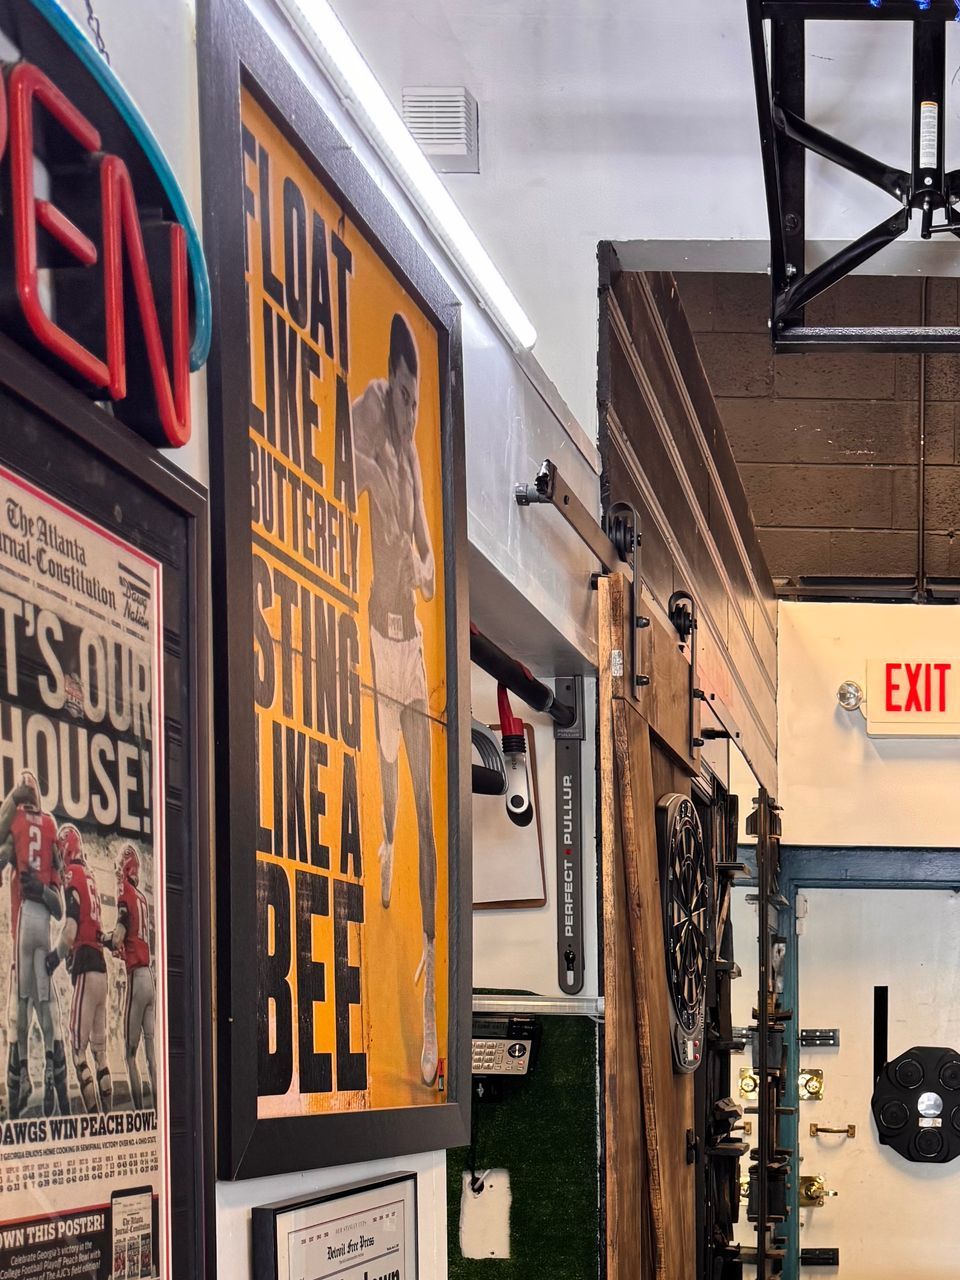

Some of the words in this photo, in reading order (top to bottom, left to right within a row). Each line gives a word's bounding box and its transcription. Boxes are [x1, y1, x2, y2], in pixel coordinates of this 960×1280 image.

[0, 62, 193, 447] EN
[242, 120, 353, 374] FLOAT
[249, 297, 324, 488] LIKE
[333, 372, 358, 514] A
[6, 497, 35, 538] The
[37, 515, 87, 567] Atlanta
[250, 438, 360, 594] BUTTERFLY
[0, 530, 117, 611] rnal-Constitution
[123, 599, 150, 630] Nation
[253, 554, 362, 752] STING
[0, 599, 65, 710] T'S
[79, 627, 152, 741] OUR
[885, 663, 951, 712] EXIT
[0, 703, 152, 834] HOUSE!
[256, 711, 330, 864] LIKE
[339, 749, 362, 878] A
[563, 774, 573, 845] PULLUP
[565, 859, 574, 937] PERFECT
[256, 859, 368, 1096] BEE
[50, 1118, 79, 1142] WIN
[81, 1114, 124, 1138] PEACH
[11, 1251, 36, 1266] Celebrate
[37, 1247, 60, 1262] Georgia's
[27, 1222, 56, 1245] THIS
[58, 1213, 105, 1238] POSTER!
[1, 1267, 21, 1280] College
